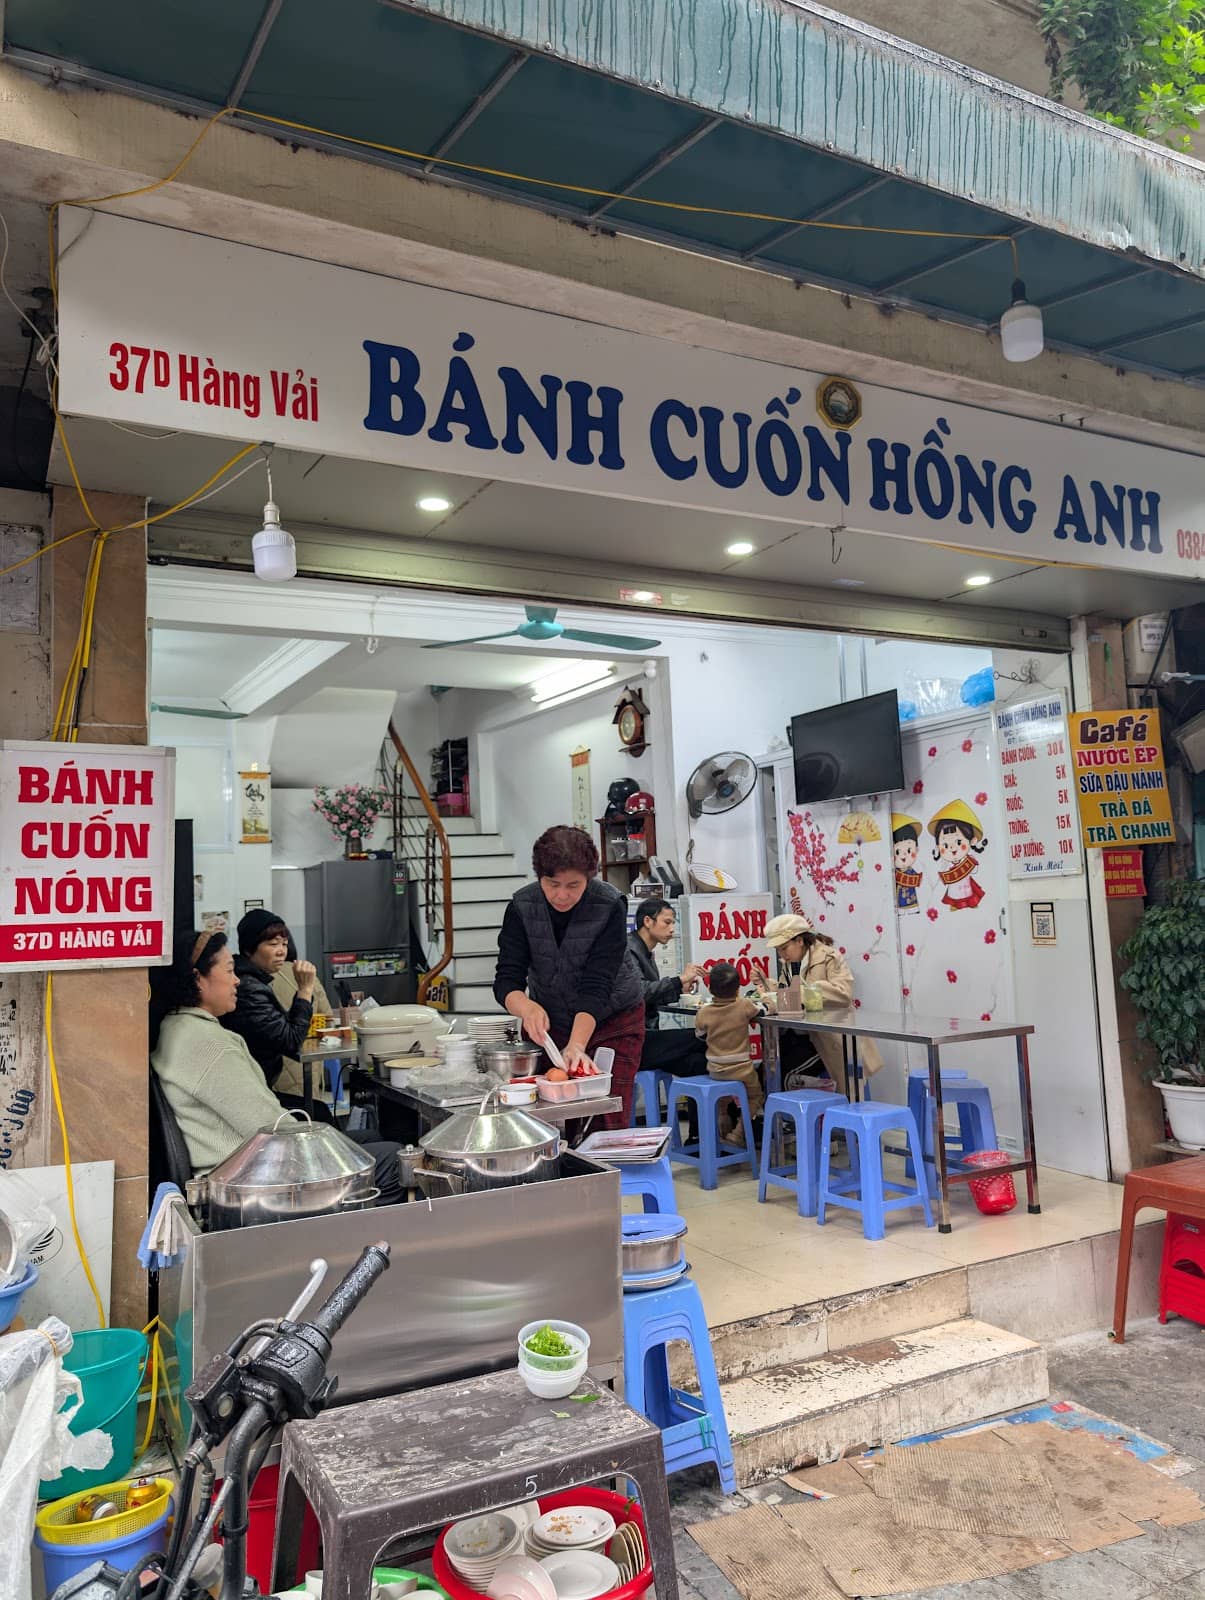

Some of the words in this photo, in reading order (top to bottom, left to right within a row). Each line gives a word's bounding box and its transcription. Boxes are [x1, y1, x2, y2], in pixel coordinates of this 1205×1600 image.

[108, 342, 170, 393] 37D
[178, 354, 260, 418] Hàng
[271, 370, 319, 422] Vải
[363, 332, 625, 469] BÁNH
[650, 388, 852, 504] CUỐN
[867, 418, 1037, 533] HỒNG
[1053, 475, 1163, 553] ANH
[1080, 715, 1148, 744] Café
[1047, 740, 1064, 756] 30K
[1077, 746, 1130, 767] NƯỚC
[1135, 744, 1158, 763] ÉP
[18, 760, 154, 805] BÁNH
[1056, 764, 1067, 780] 5K
[1080, 771, 1103, 793] SỮA
[1105, 770, 1128, 795] ĐẬU
[1058, 789, 1069, 804] 5K
[1099, 798, 1128, 818] TRÀ
[1132, 796, 1152, 815] ĐÁ
[1056, 813, 1072, 829] 15K
[1087, 822, 1117, 843] TRÀ
[1121, 822, 1171, 840] CHANH
[21, 809, 151, 859] CUỐN
[1059, 838, 1073, 854] 10K
[14, 870, 153, 915] NÓNG
[698, 903, 767, 940] BÁNH
[13, 932, 53, 950] 37D
[59, 924, 115, 949] HÀNG
[121, 922, 152, 946] VẢI
[525, 1474, 538, 1495] 5
